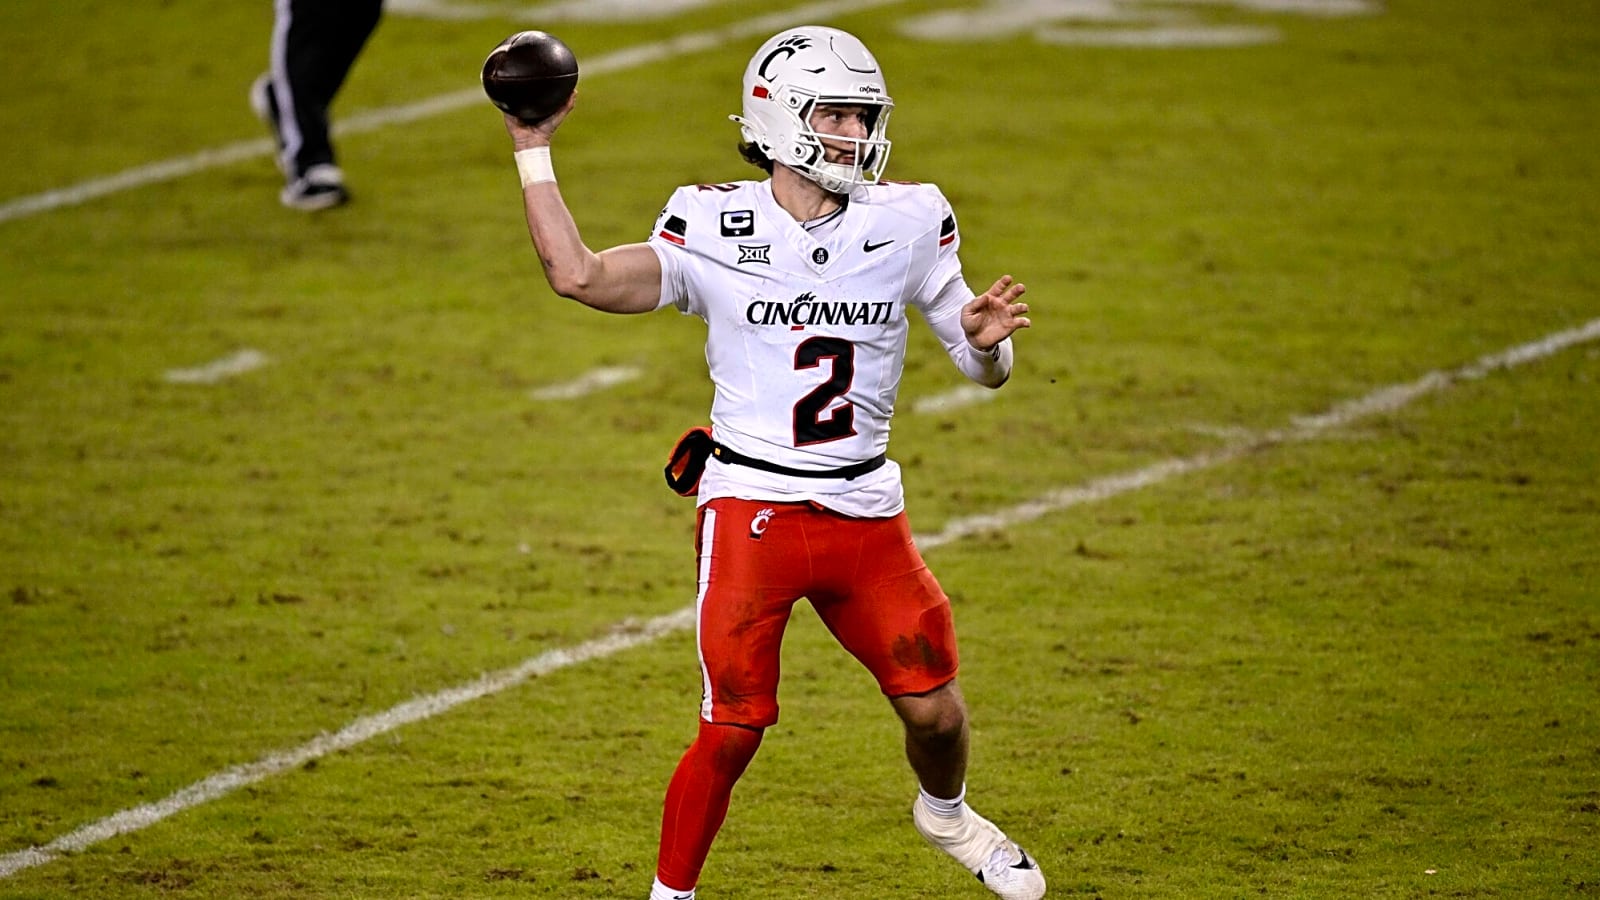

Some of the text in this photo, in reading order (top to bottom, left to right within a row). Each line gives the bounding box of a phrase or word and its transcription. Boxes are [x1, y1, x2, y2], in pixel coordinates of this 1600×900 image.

[723, 212, 751, 229] C
[746, 298, 894, 326] CINCINNATI
[793, 336, 858, 447] 2
